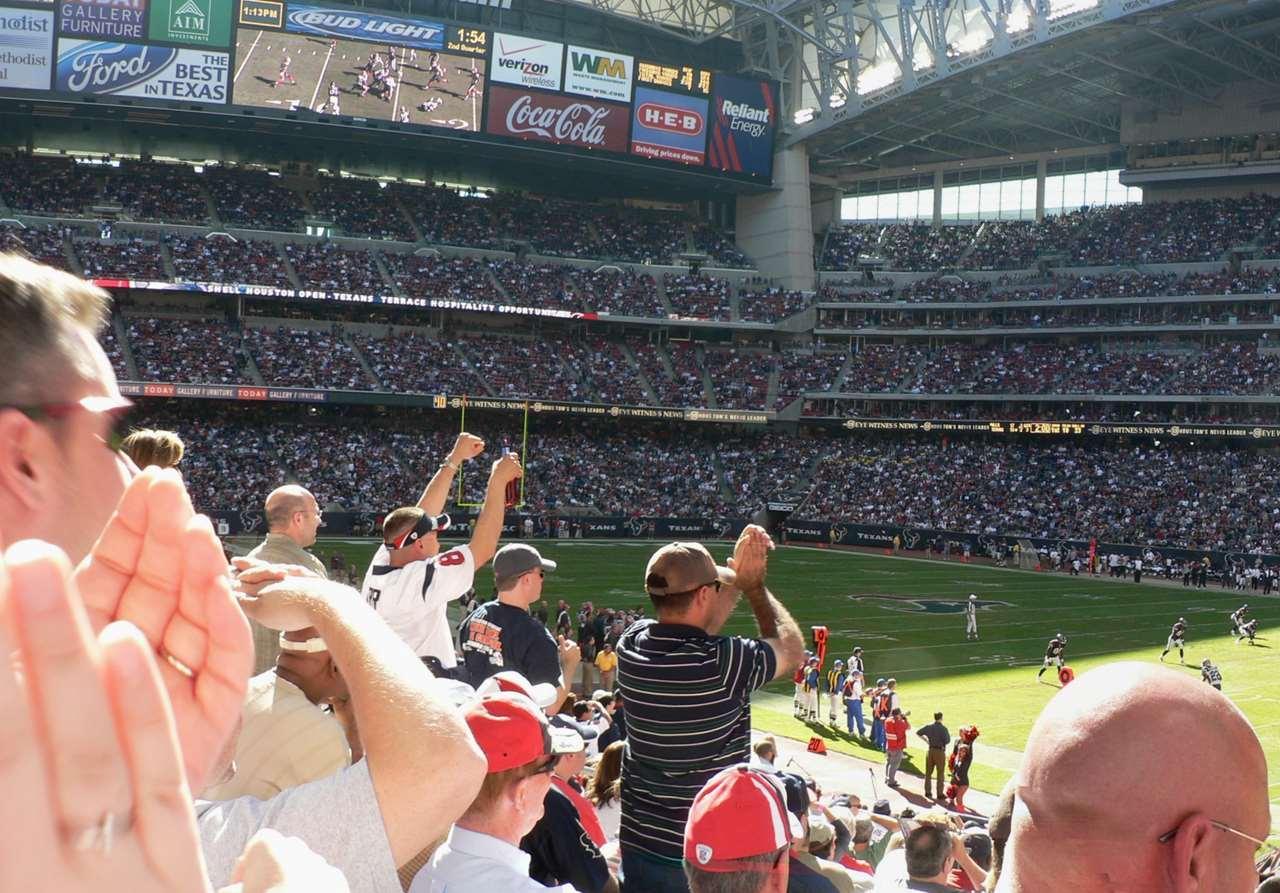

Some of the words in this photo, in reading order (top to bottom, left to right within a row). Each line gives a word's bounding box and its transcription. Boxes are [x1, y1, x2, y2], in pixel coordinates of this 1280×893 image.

[62, 4, 143, 23] GALLERY
[243, 5, 277, 18] 1:13PM
[61, 18, 143, 38] FURNITURE
[173, 16, 204, 31] AIM
[305, 13, 362, 30] BUD
[363, 19, 441, 41] LIGHT
[457, 28, 486, 45] 1:54
[68, 45, 151, 92] Ford
[202, 54, 227, 66] THE
[498, 57, 548, 76] verizon
[571, 52, 626, 80] WM
[176, 63, 227, 83] BEST
[521, 74, 556, 88] wireless
[144, 84, 158, 94] IN
[158, 80, 225, 100] TEXAS
[506, 95, 609, 146] Coca-Cola
[722, 100, 769, 123] Reliant
[635, 145, 659, 158] Driving
[660, 148, 681, 161] prices
[207, 285, 240, 295] SHELL
[246, 286, 295, 297] HOUSTON
[299, 291, 326, 300] OPEN
[334, 292, 374, 304] TEXANS
[381, 295, 427, 307] TERRACE
[430, 299, 495, 312] HOSPITALITY
[144, 387, 174, 395] TODAY
[177, 387, 202, 396] GALLERY
[238, 389, 267, 398] TODAY
[269, 391, 295, 399] GALLERY
[787, 527, 822, 536] TEXANS
[857, 532, 893, 542] TEXANS
